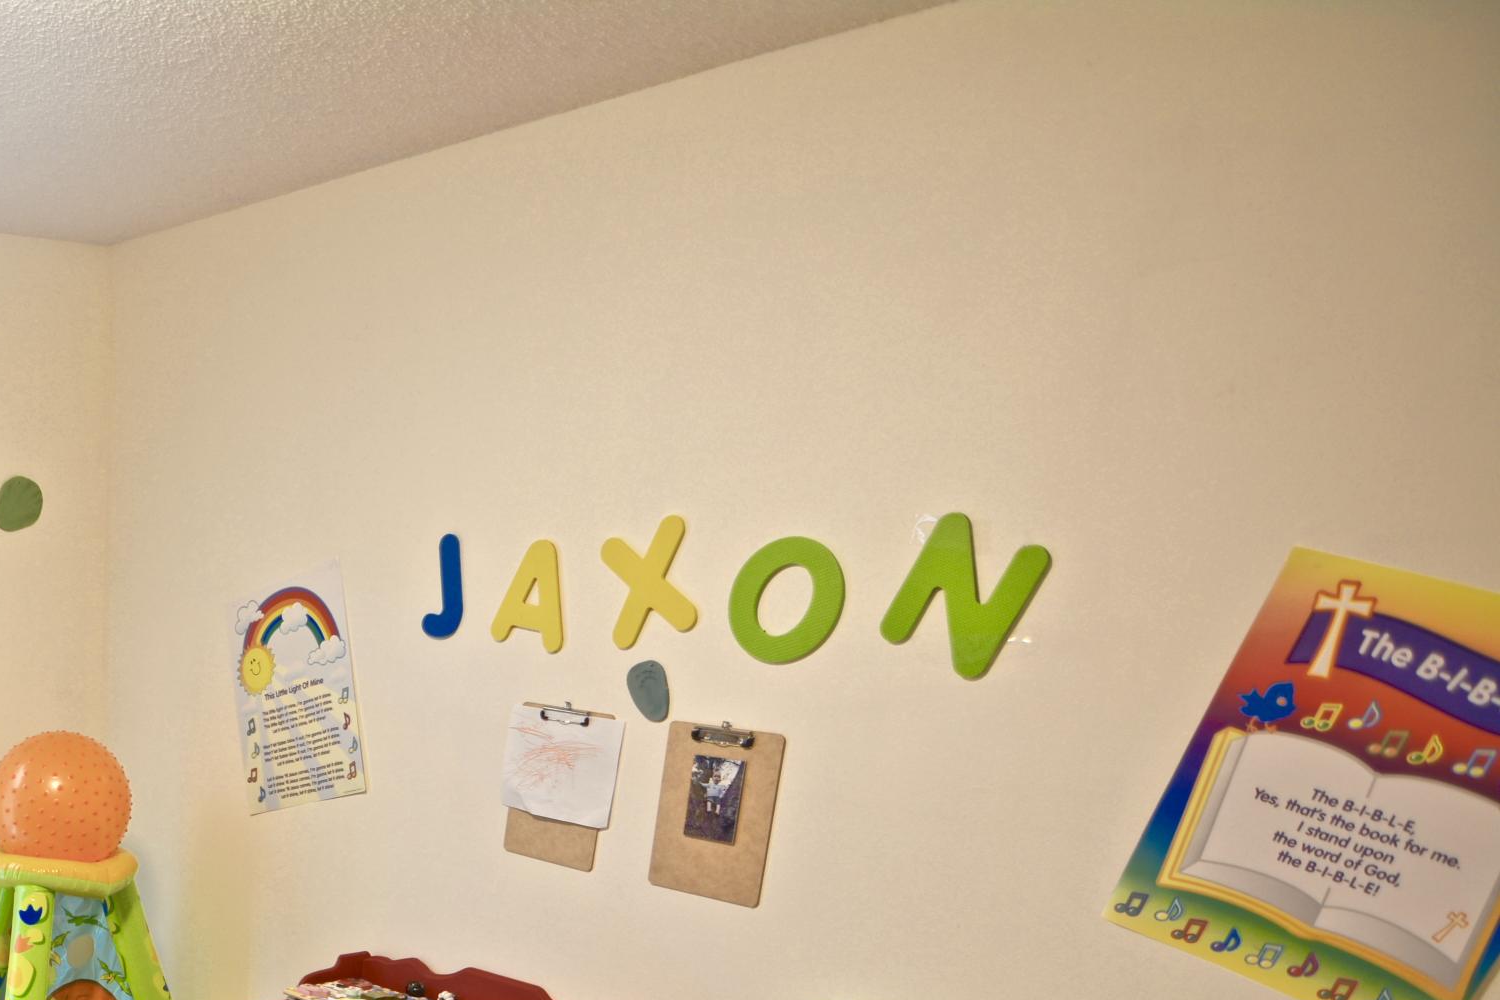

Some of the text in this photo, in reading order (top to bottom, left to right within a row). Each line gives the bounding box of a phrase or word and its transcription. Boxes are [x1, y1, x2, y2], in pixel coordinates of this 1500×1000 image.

[421, 511, 1052, 680] JAXON
[1358, 629, 1413, 668] The
[1253, 786, 1461, 870] Yes, that's the book for me.
[1311, 788, 1416, 836] The B-I-B-L-E,
[1272, 830, 1401, 888] the word of God,
[1296, 820, 1395, 865] I stand upon
[1276, 850, 1381, 897] the B-I-B-L-E!
